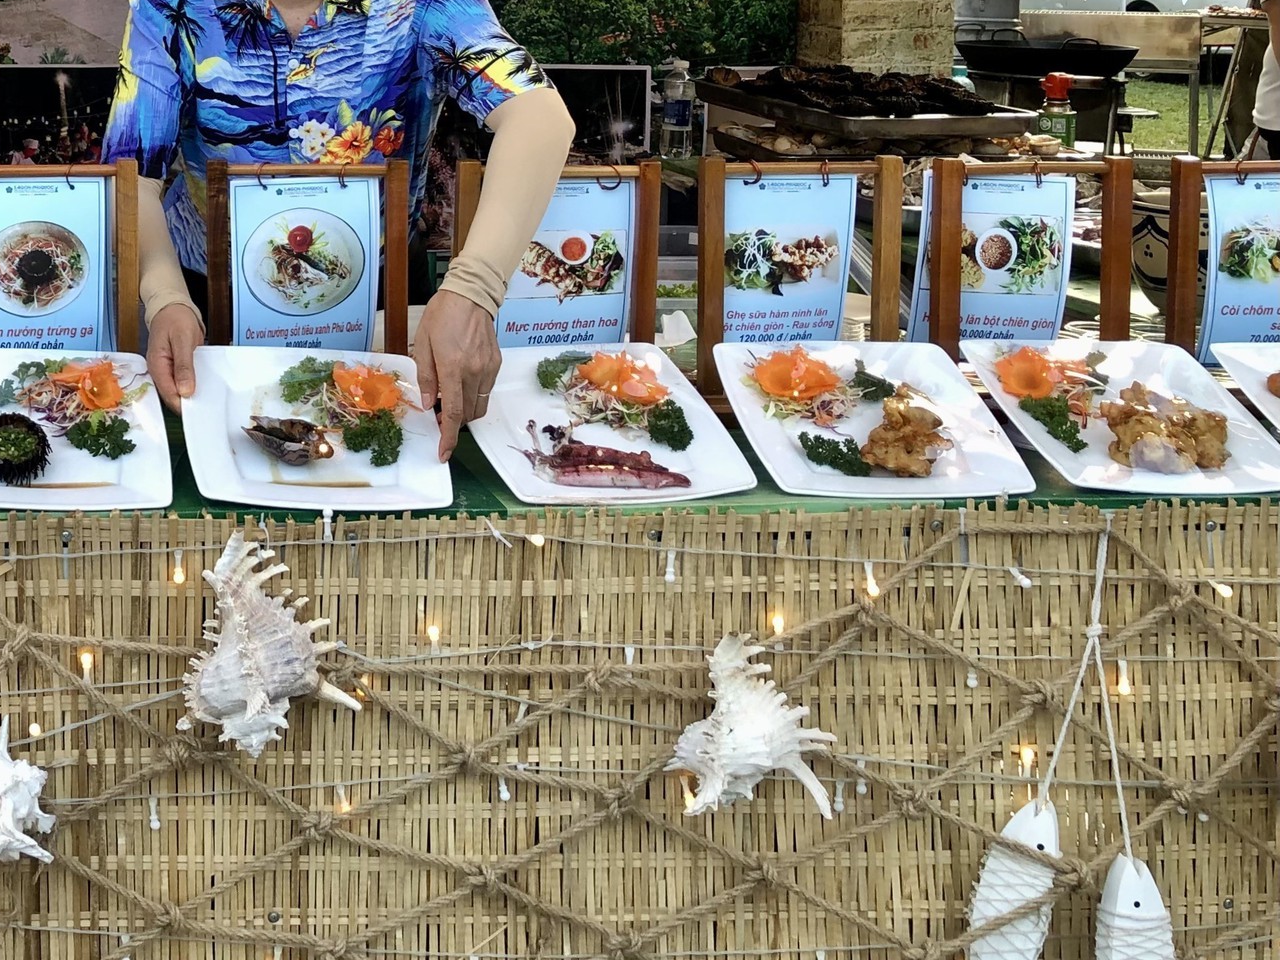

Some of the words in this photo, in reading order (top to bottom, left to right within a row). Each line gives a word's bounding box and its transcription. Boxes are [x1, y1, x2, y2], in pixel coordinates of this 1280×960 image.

[726, 310, 746, 321] Ghẹ
[748, 309, 766, 319] sữa
[769, 309, 789, 319] hàm
[791, 308, 812, 317] ninh
[1221, 305, 1240, 316] Còi
[290, 323, 301, 336] sốt
[314, 323, 331, 334] xanh
[331, 321, 345, 333] Phú
[346, 318, 363, 332] Quốc
[505, 321, 529, 334] Mực
[532, 319, 568, 332] nướng
[572, 317, 595, 329] than
[598, 317, 618, 327] hoa
[723, 322, 732, 332] ột
[735, 321, 760, 332] chiên
[763, 321, 784, 332] giòn
[792, 320, 810, 329] Rau
[812, 317, 835, 329] sống
[966, 313, 980, 325] lăn
[983, 315, 1000, 328] bột
[1002, 316, 1029, 329] chiên
[1031, 319, 1054, 330] giòn
[7, 326, 44, 339] nướng
[47, 324, 77, 338] trứng
[80, 324, 94, 338] gà
[527, 333, 570, 344] 110.000/đ
[571, 330, 594, 344] phần
[739, 333, 774, 342] 120.000
[776, 333, 784, 341] đ
[789, 330, 812, 341] phần
